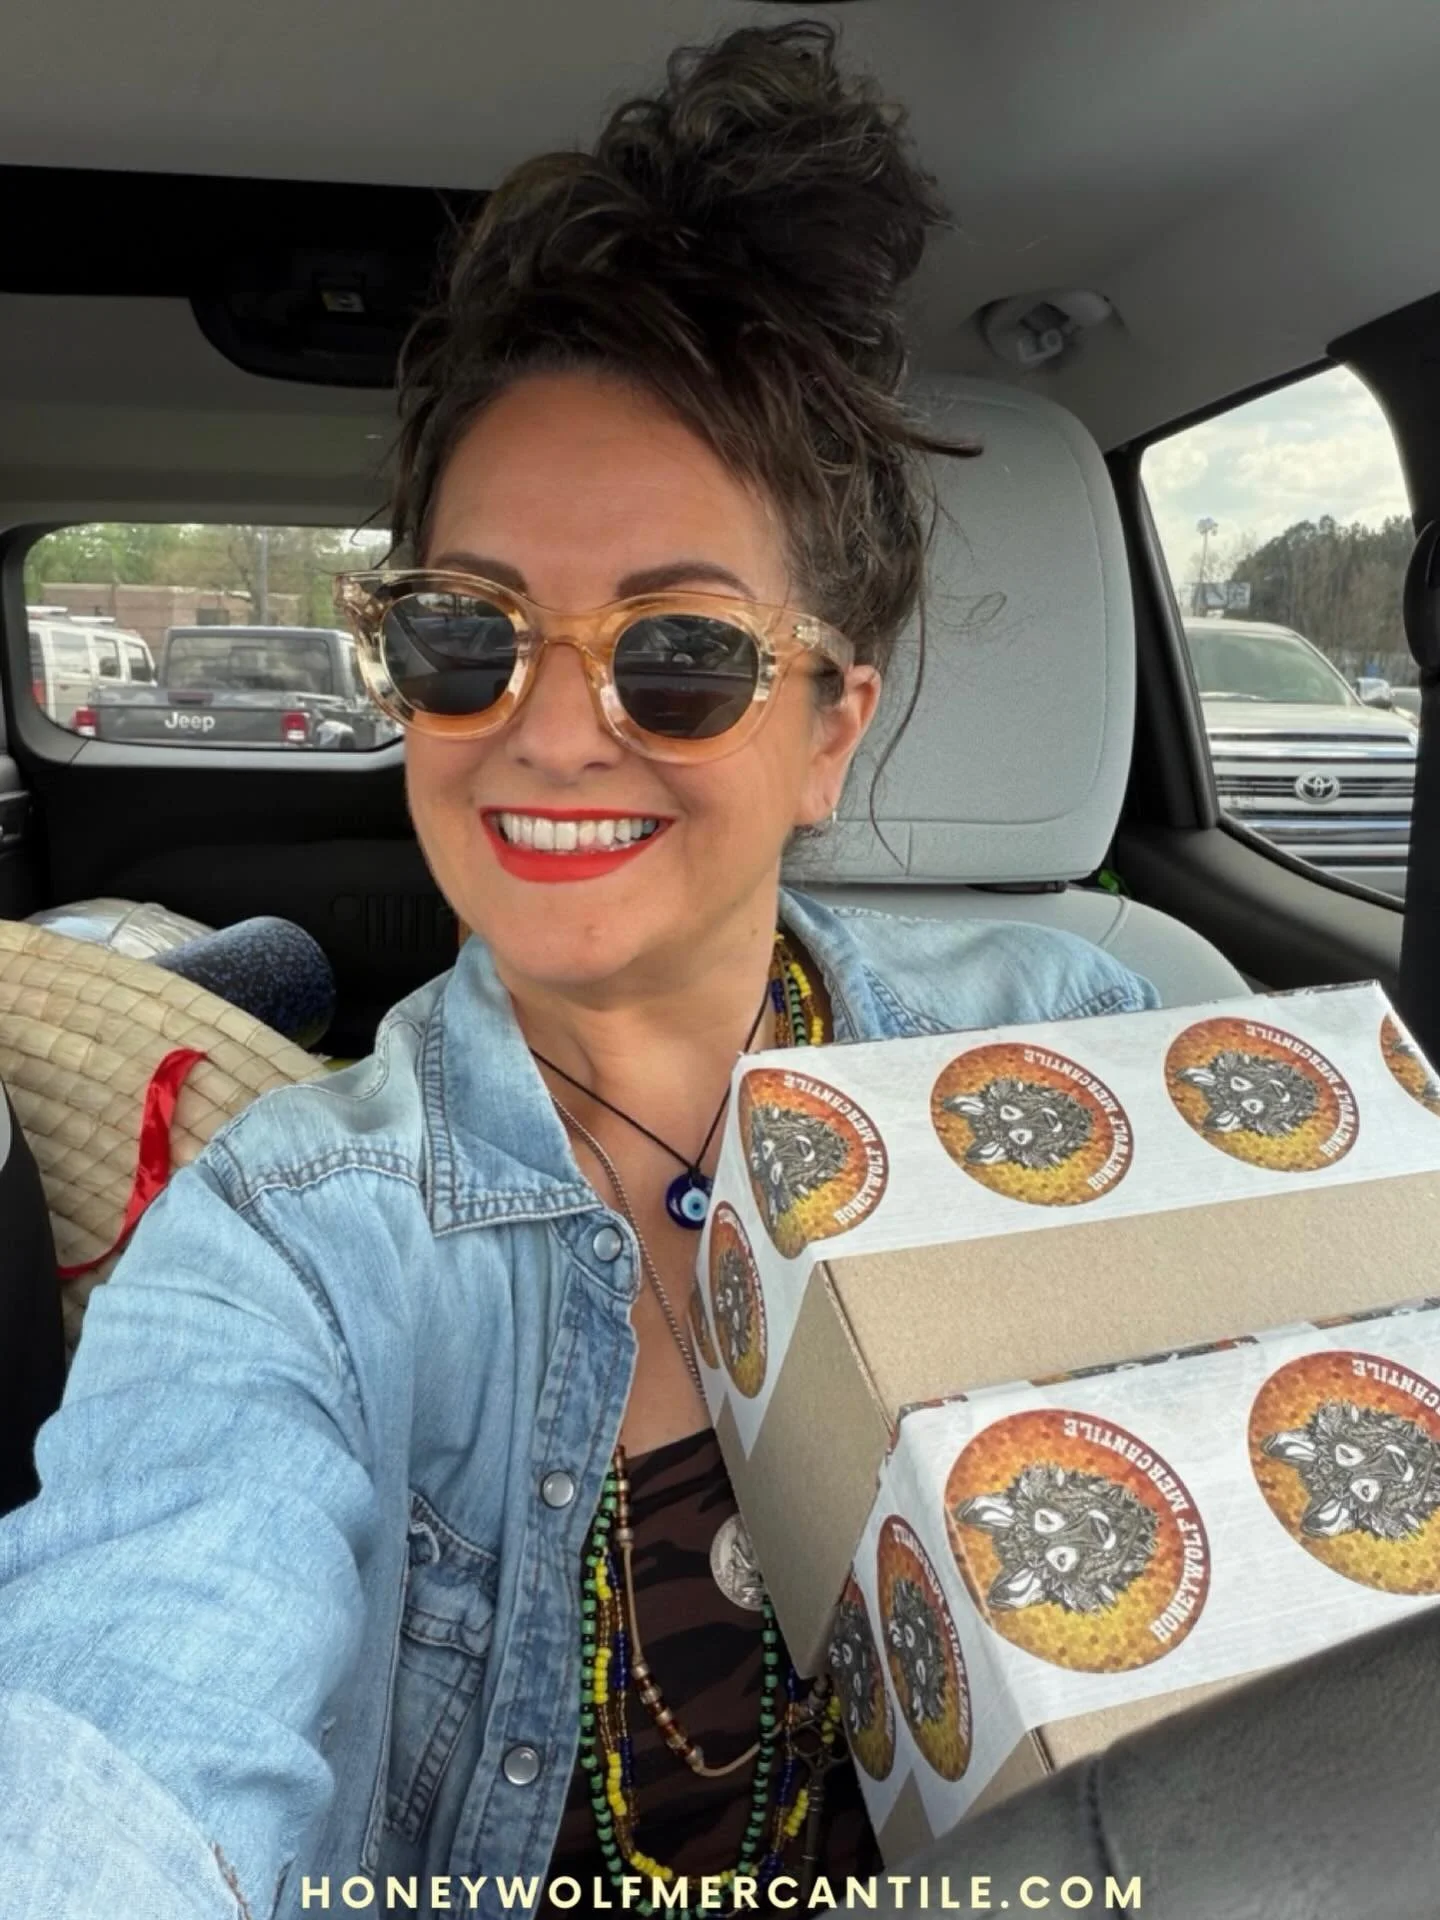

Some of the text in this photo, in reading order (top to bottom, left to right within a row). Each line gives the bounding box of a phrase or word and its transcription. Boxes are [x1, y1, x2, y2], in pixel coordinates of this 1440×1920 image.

[164, 711, 216, 733] Jeep
[1024, 1050, 1119, 1113] MERCANTILE
[1245, 1024, 1342, 1085] MERCANTILE
[784, 1073, 877, 1143] MERCANTILE
[1064, 1418, 1205, 1643] HONEYWOLF MERCANTILE
